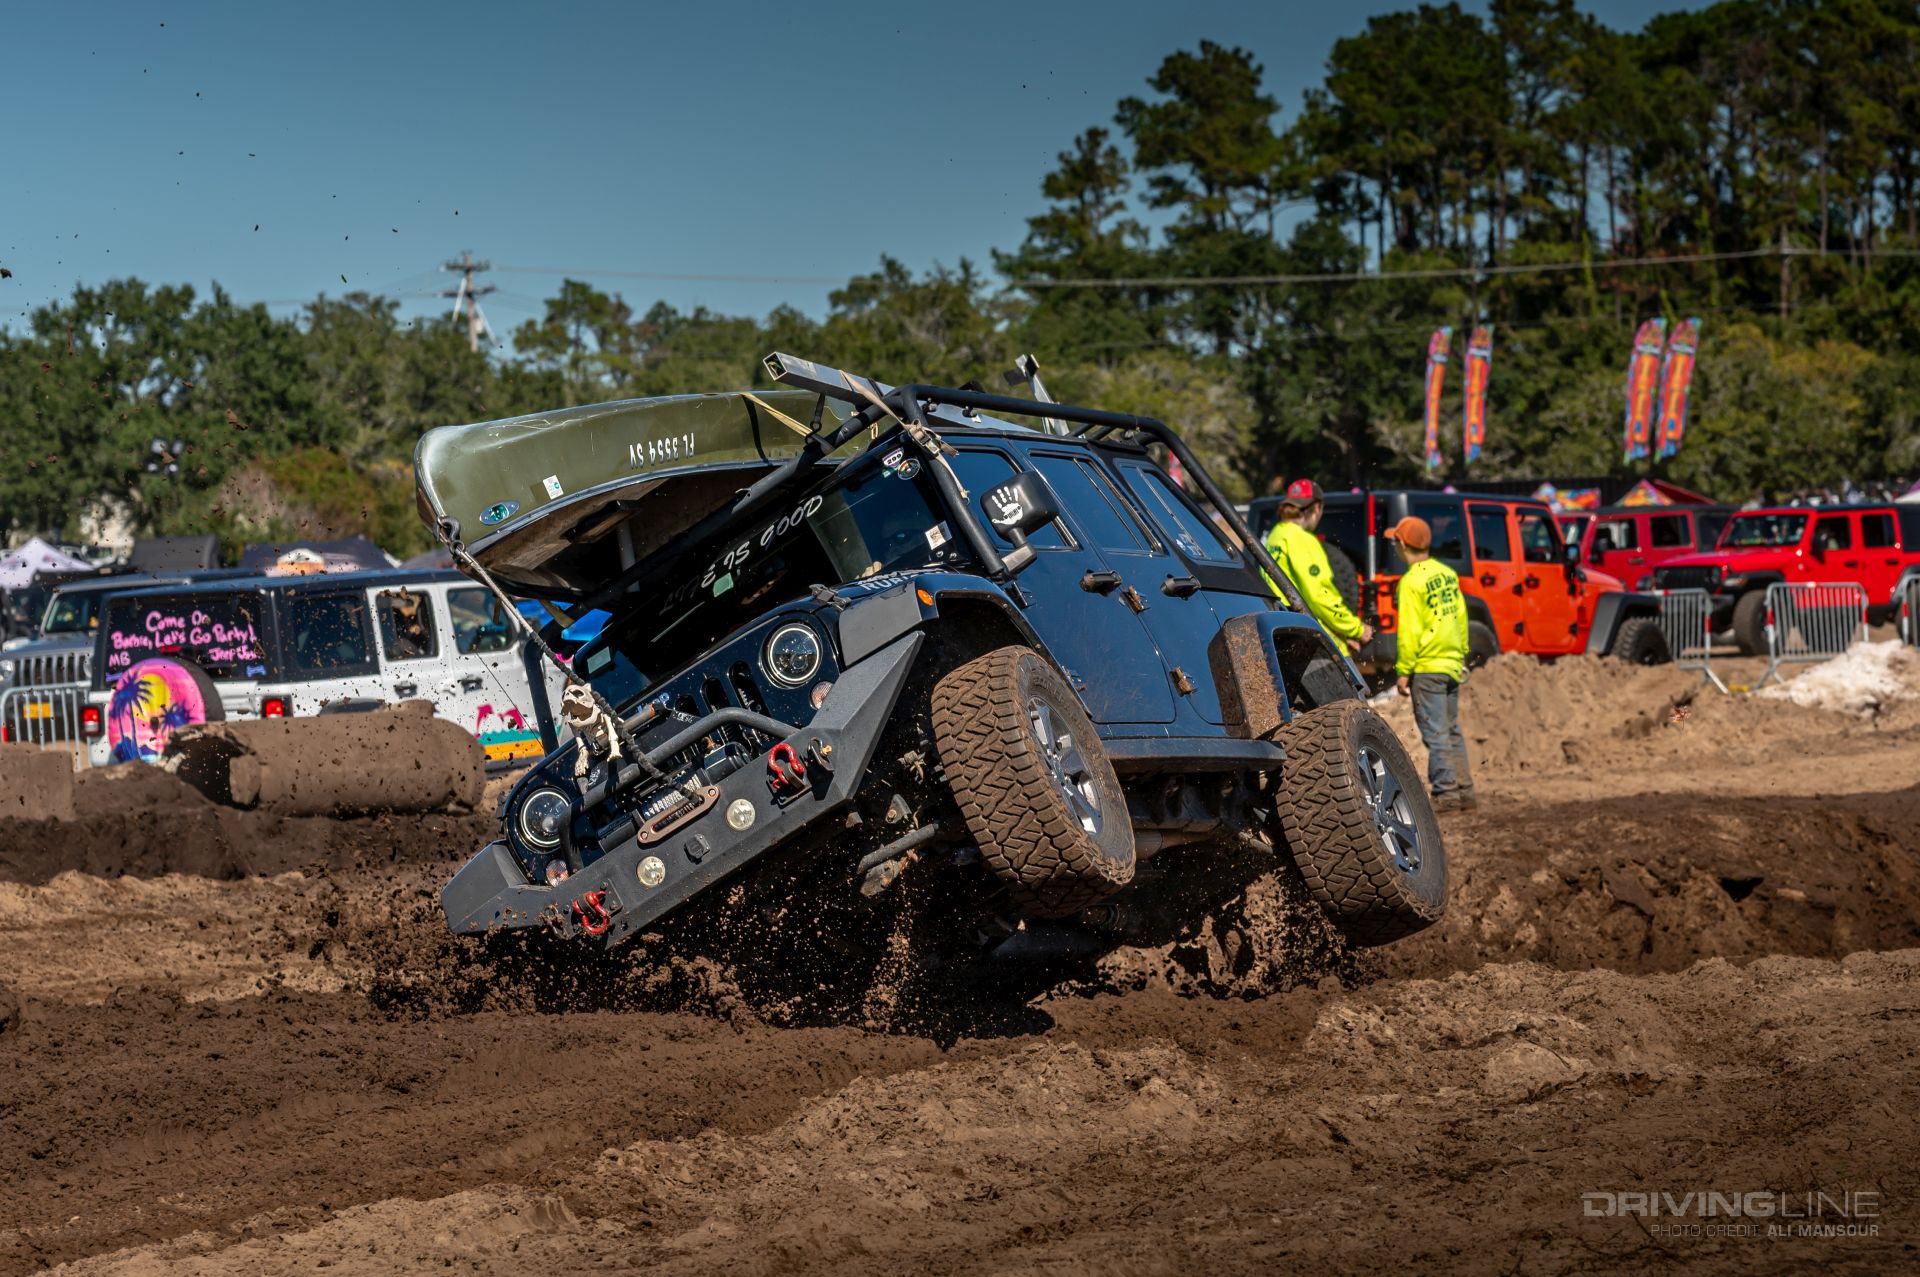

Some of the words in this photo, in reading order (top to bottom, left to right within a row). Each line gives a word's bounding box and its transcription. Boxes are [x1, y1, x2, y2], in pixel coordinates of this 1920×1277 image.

[629, 443, 644, 468] SV
[648, 436, 679, 465] 3554
[682, 432, 695, 457] FL
[723, 541, 751, 570] IS
[759, 495, 823, 550] GOOD
[145, 610, 186, 632] Come
[190, 626, 212, 645] Go
[109, 651, 131, 667] MB
